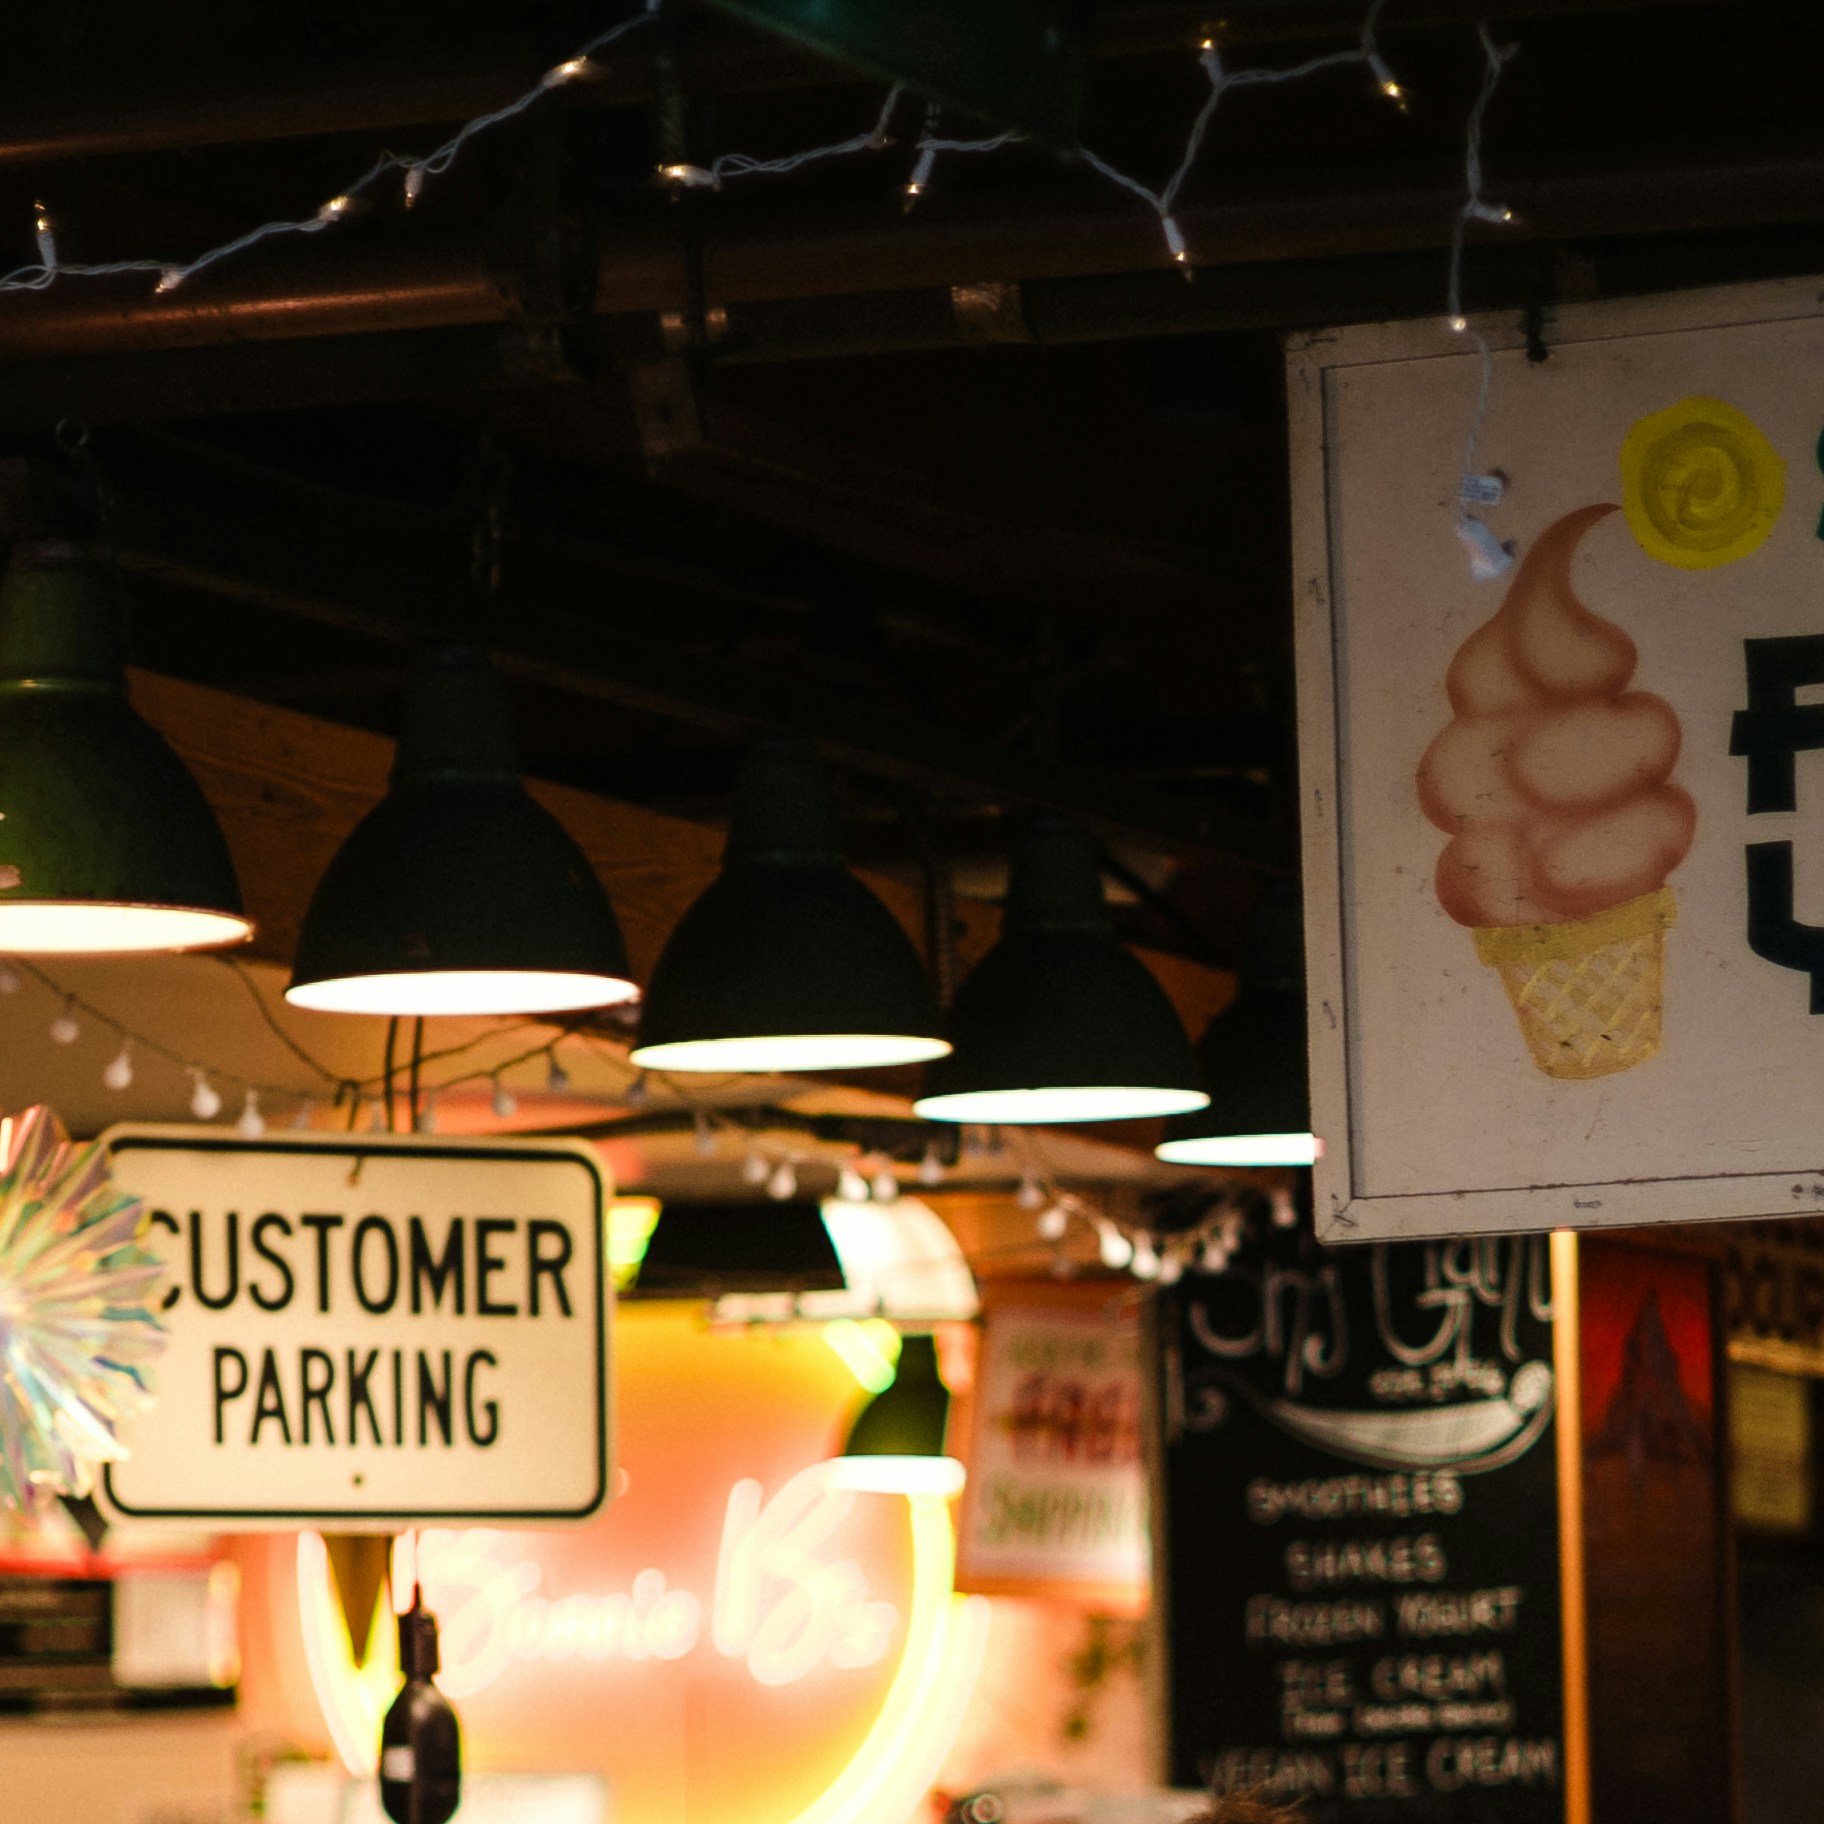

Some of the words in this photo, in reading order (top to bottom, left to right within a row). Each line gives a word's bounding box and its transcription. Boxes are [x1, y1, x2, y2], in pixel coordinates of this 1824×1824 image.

[212, 1346, 501, 1450] PARKING
[1245, 1469, 1466, 1527] SMOOTHIES
[1283, 1531, 1449, 1592] SHAKES
[1244, 1592, 1386, 1651] FROZEN
[1392, 1584, 1526, 1640] YOGURT
[1279, 1658, 1359, 1709] ICE
[1371, 1649, 1509, 1701] CREAM
[1340, 1741, 1422, 1800] ICE
[1425, 1736, 1560, 1793] CREAM
